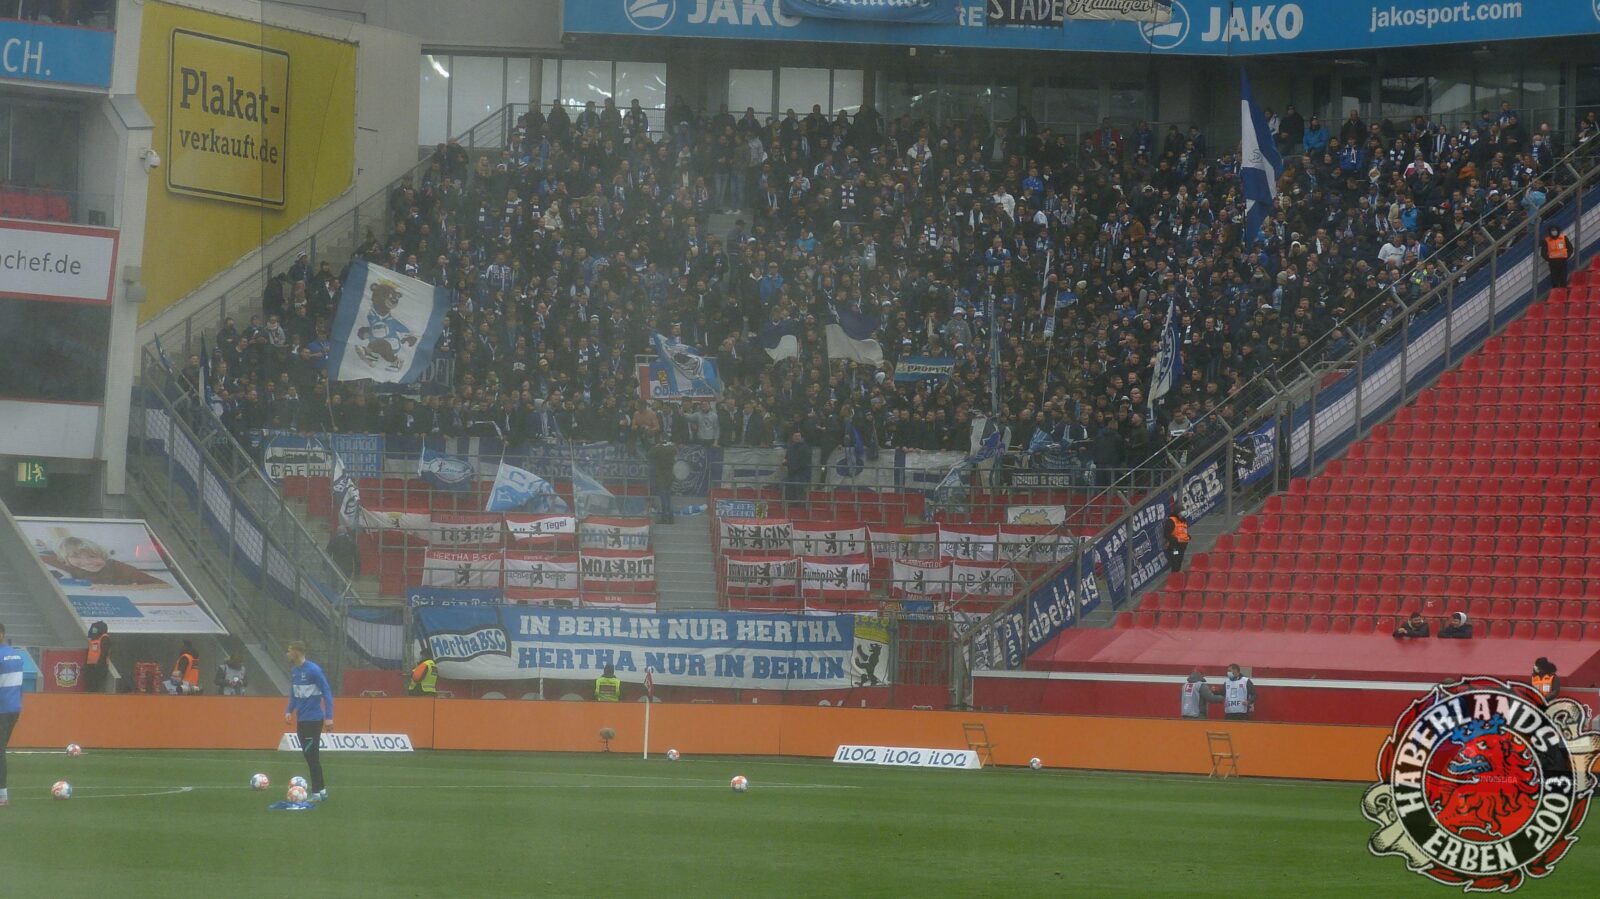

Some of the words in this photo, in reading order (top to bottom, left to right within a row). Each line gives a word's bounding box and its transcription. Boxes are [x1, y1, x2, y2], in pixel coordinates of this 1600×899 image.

[1202, 3, 1304, 42] JAKO
[1369, 2, 1522, 32] jakosport.com
[180, 67, 280, 124] Plakat-
[179, 127, 278, 164] verkauft.de
[544, 520, 567, 531] Tegel
[1132, 503, 1166, 532] CLUB
[433, 550, 469, 560] HERTHA
[519, 615, 551, 635] IN
[558, 616, 660, 640] BERLIN
[667, 618, 729, 641] NUR
[736, 620, 842, 643] HERTHA
[518, 647, 637, 672] HERTHA
[645, 652, 706, 677] NUR
[714, 655, 745, 678] IN
[752, 655, 845, 679] BERLIN
[289, 734, 326, 751] iLQ
[330, 735, 368, 751] iLOQ
[372, 735, 410, 751] iLOQ
[838, 745, 876, 762] iLOQ
[883, 748, 921, 764] iLOQ
[928, 750, 967, 766] iLOQ
